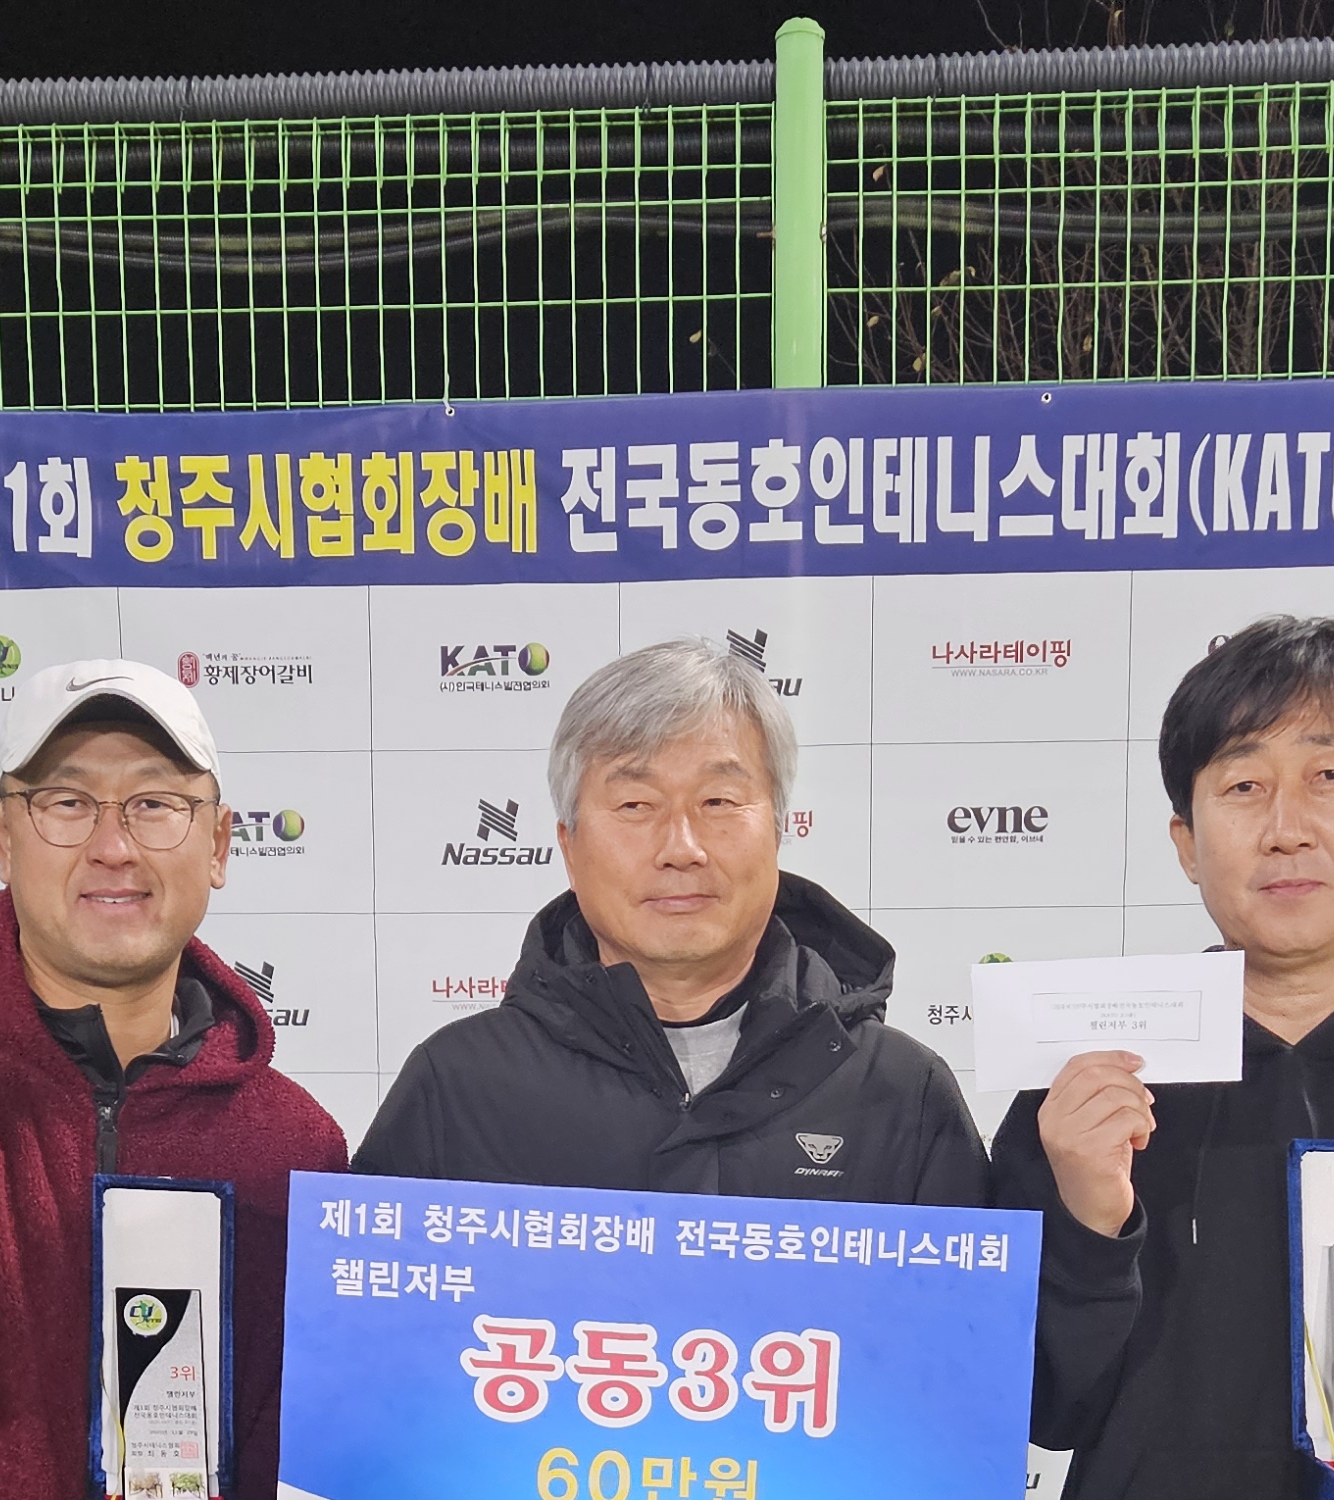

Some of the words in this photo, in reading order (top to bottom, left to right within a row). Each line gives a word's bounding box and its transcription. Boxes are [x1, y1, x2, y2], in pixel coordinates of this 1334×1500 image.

[115, 449, 538, 562] 청주시협회장배
[932, 639, 1072, 668] 나사라테이핑
[203, 664, 314, 686] 황제장어갈비
[947, 805, 1050, 834] evne
[441, 842, 554, 866] Nassau
[794, 1167, 845, 1178] DYNAFIT
[319, 1199, 402, 1240] 제1회
[423, 1204, 656, 1255] 청주시협회장배
[675, 1219, 1009, 1272] 전국동호인테니스대회
[331, 1258, 476, 1303] 챌린저부
[170, 1365, 196, 1381] 3위
[462, 1315, 839, 1437] 공동3위
